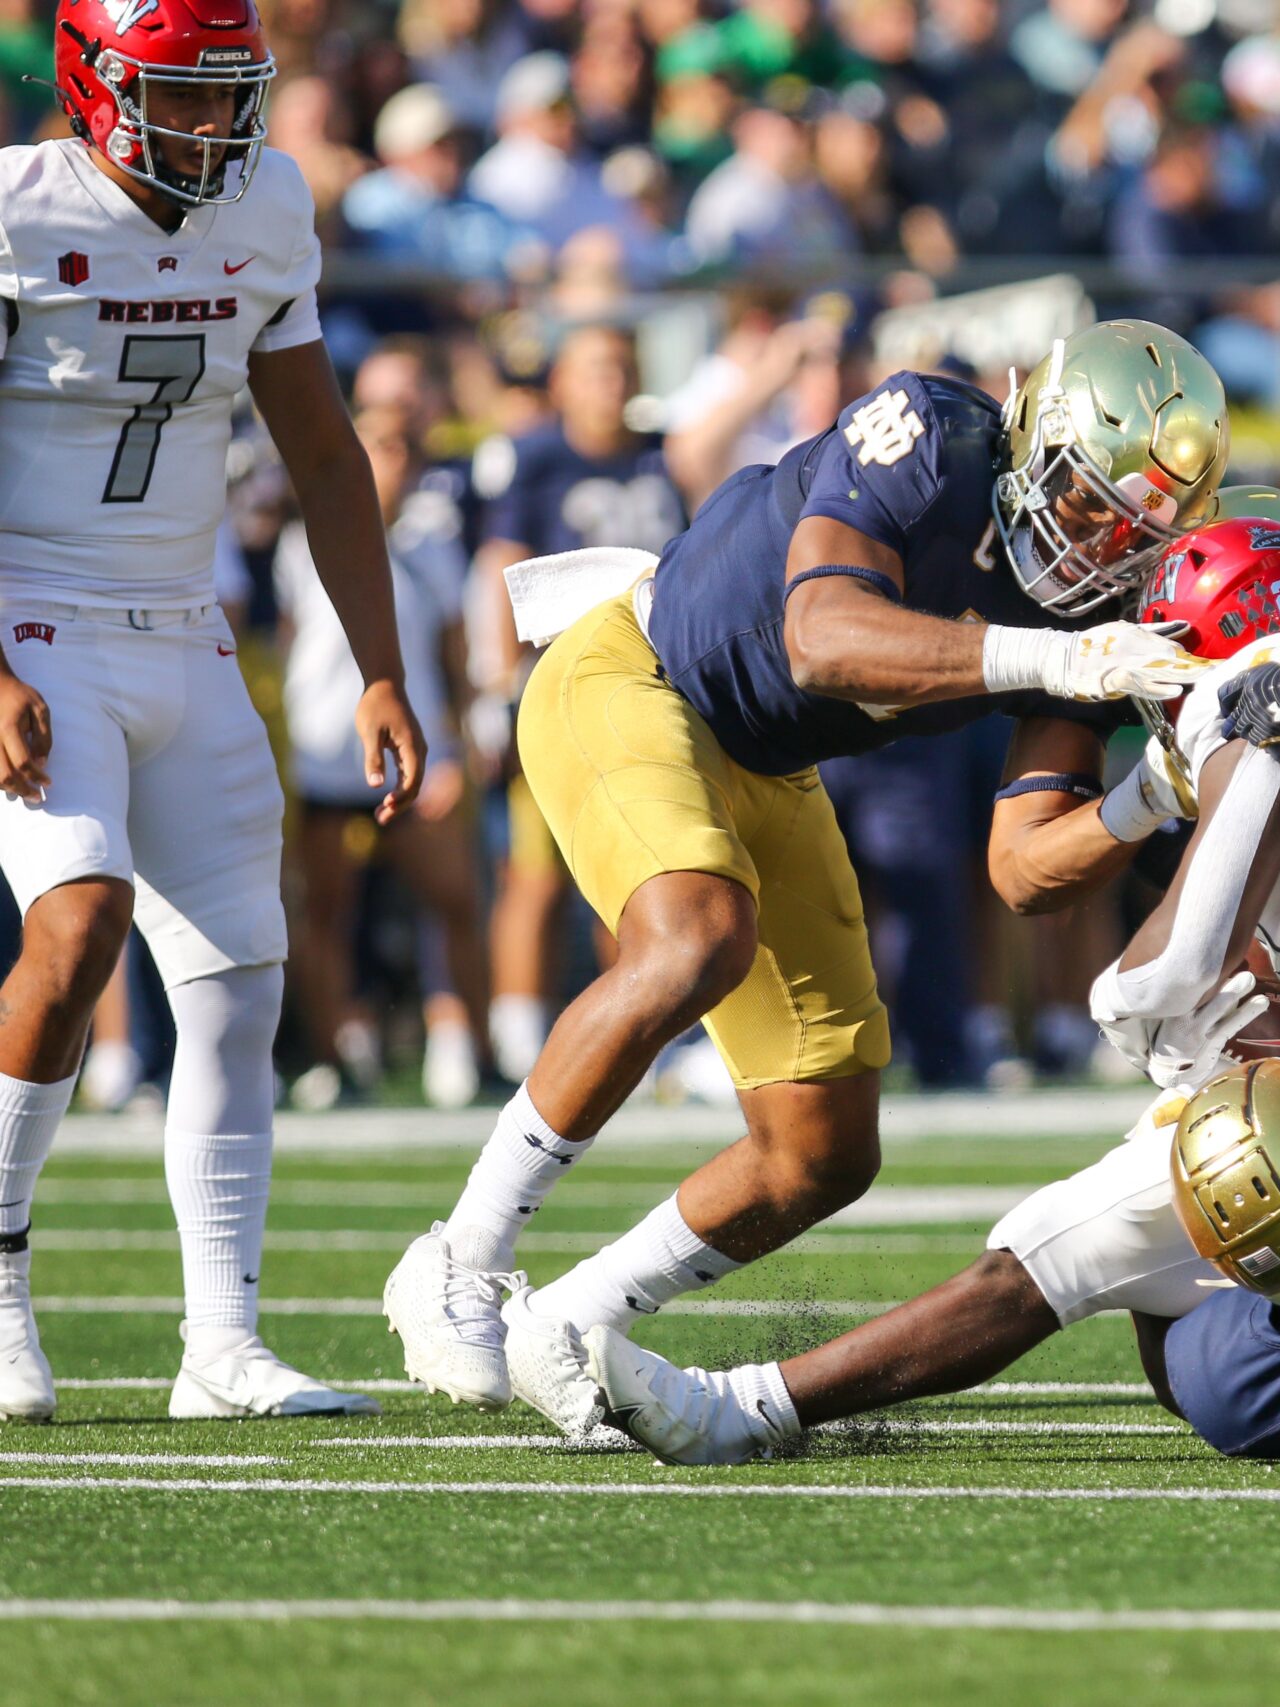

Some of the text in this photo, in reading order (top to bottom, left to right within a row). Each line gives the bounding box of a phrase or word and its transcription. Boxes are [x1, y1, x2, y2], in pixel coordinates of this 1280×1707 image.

[206, 52, 251, 61] REBELS
[98, 297, 238, 323] REBELS
[101, 333, 206, 503] 7
[843, 389, 926, 468] ND
